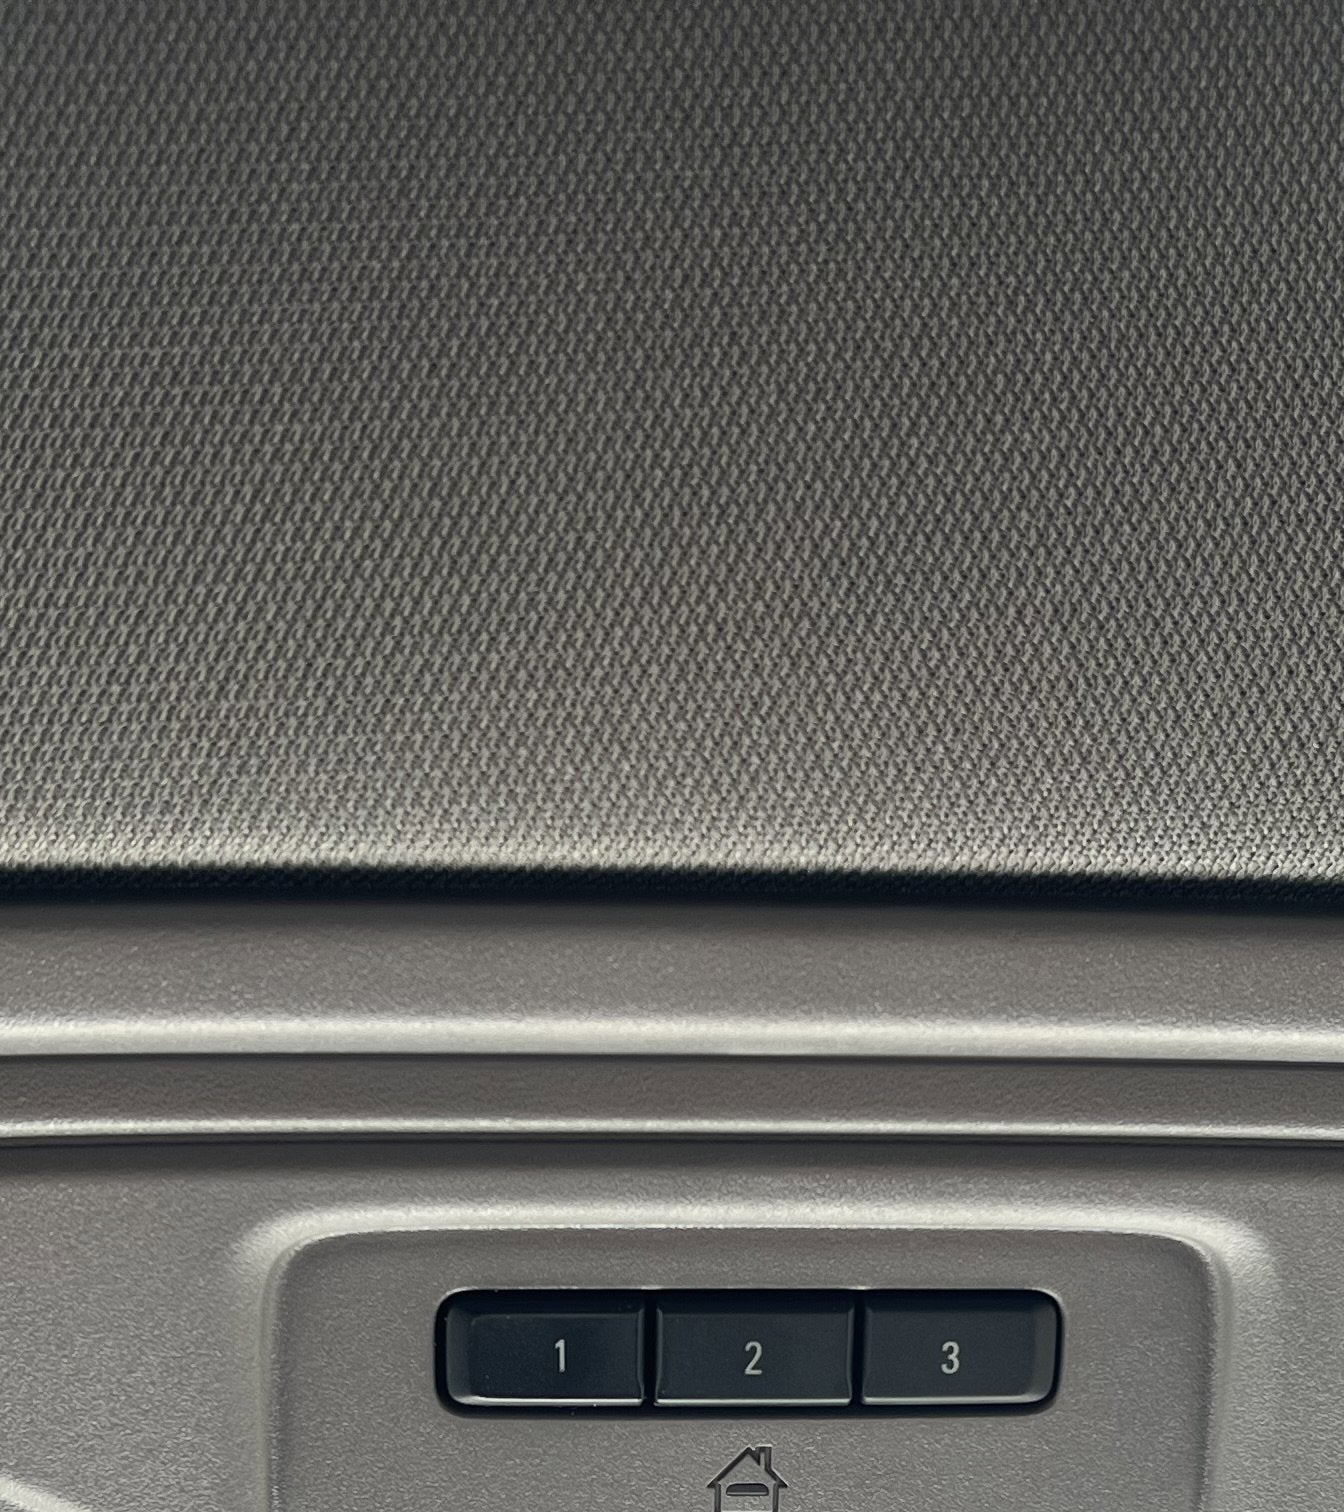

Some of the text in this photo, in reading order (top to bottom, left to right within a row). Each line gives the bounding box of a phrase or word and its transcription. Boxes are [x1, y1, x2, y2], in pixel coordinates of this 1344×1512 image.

[554, 1339, 566, 1373] 1
[745, 1342, 763, 1375] 2
[941, 1342, 960, 1375] 3
